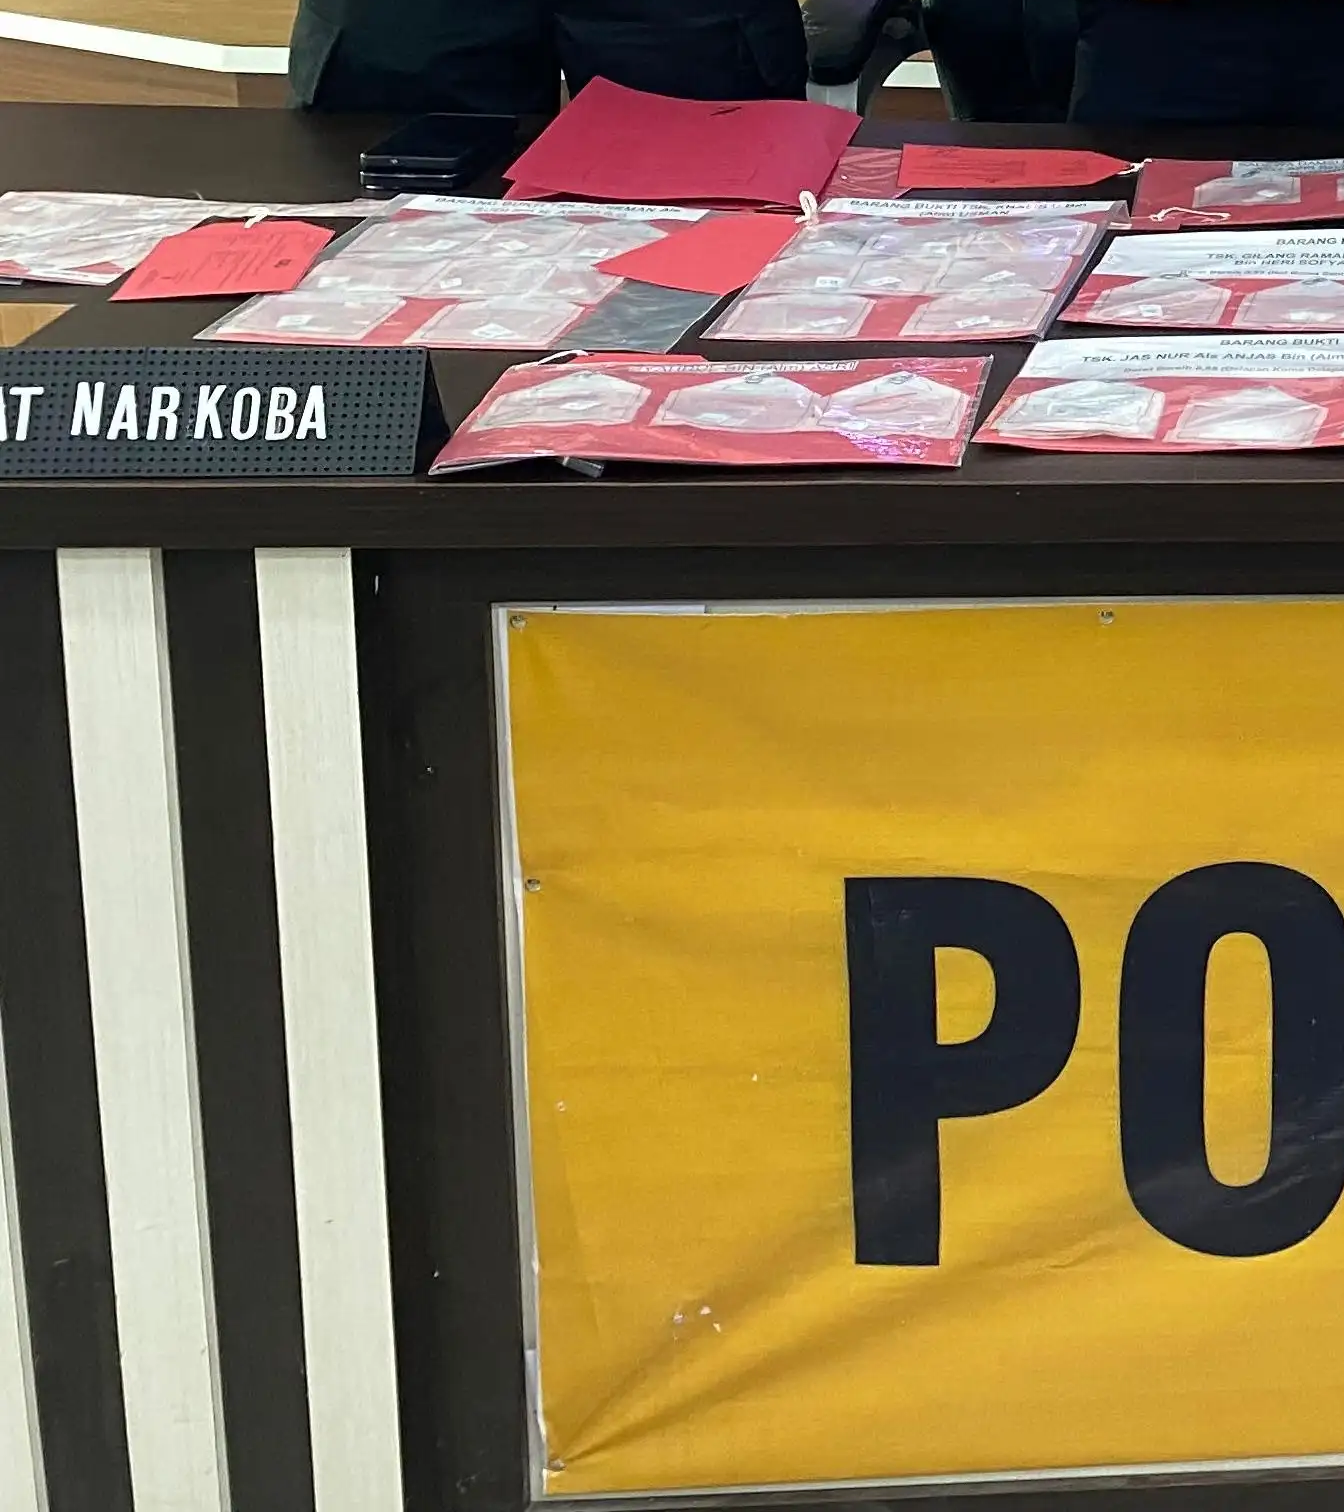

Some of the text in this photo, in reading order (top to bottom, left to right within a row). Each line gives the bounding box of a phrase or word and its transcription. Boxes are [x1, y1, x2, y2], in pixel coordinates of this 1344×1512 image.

[849, 199, 913, 210] BARANG
[1275, 236, 1338, 246] BARANG
[1241, 252, 1297, 260] GILANG
[1220, 338, 1340, 347] BARANG BUKTI
[1120, 353, 1152, 361] JAS
[1156, 352, 1190, 360] NUR
[1221, 352, 1277, 361] ANJAS
[70, 381, 328, 441] NARKOBA
